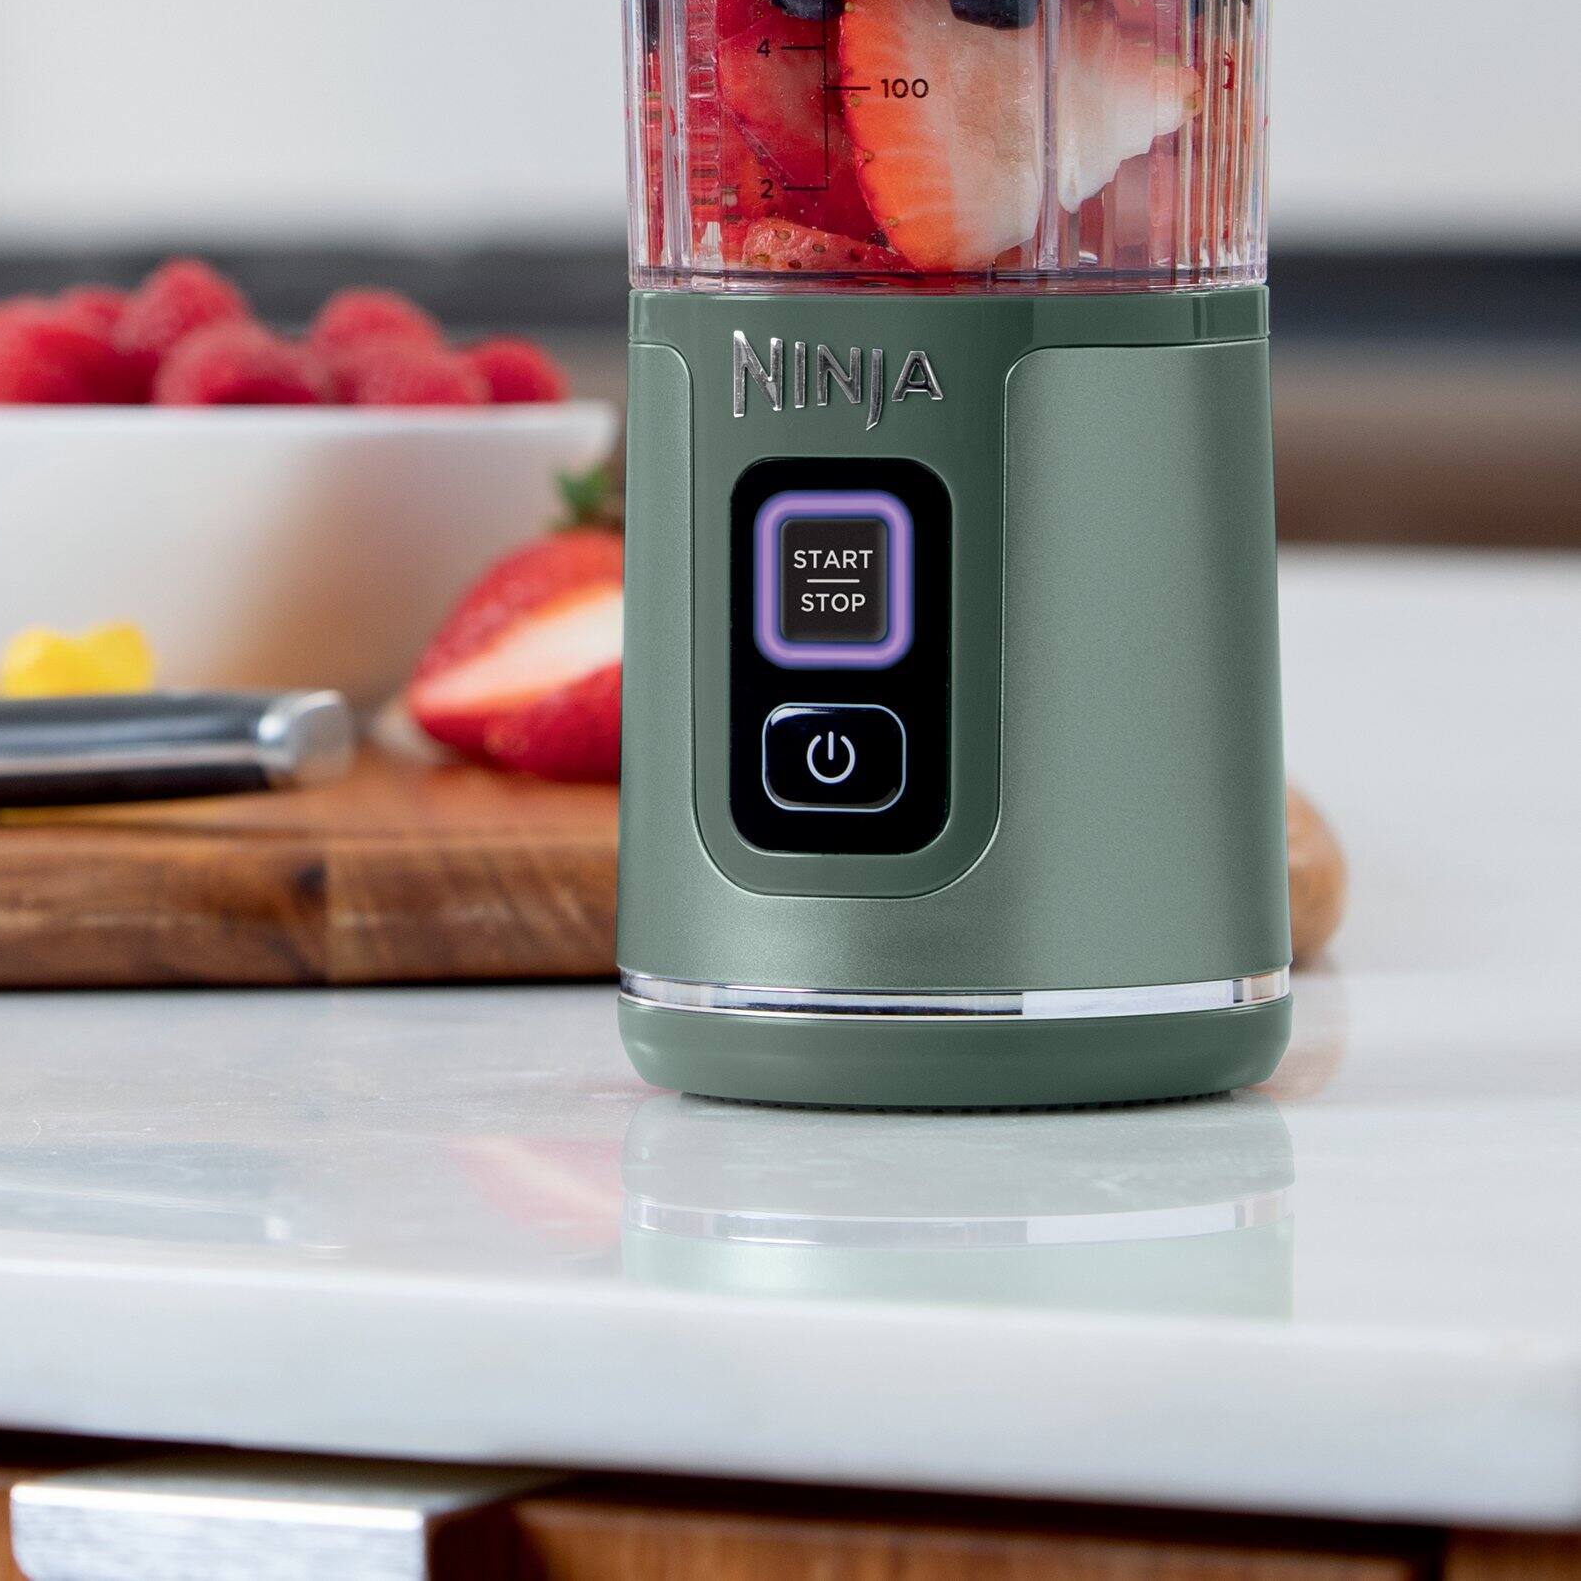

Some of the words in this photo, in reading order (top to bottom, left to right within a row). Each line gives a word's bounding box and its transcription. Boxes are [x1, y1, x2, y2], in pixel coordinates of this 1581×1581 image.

[756, 38, 771, 58] 4
[880, 78, 929, 99] 100
[760, 178, 774, 199] 2
[733, 330, 944, 431] NINJA
[793, 549, 874, 569] START
[800, 593, 867, 613] STOP
